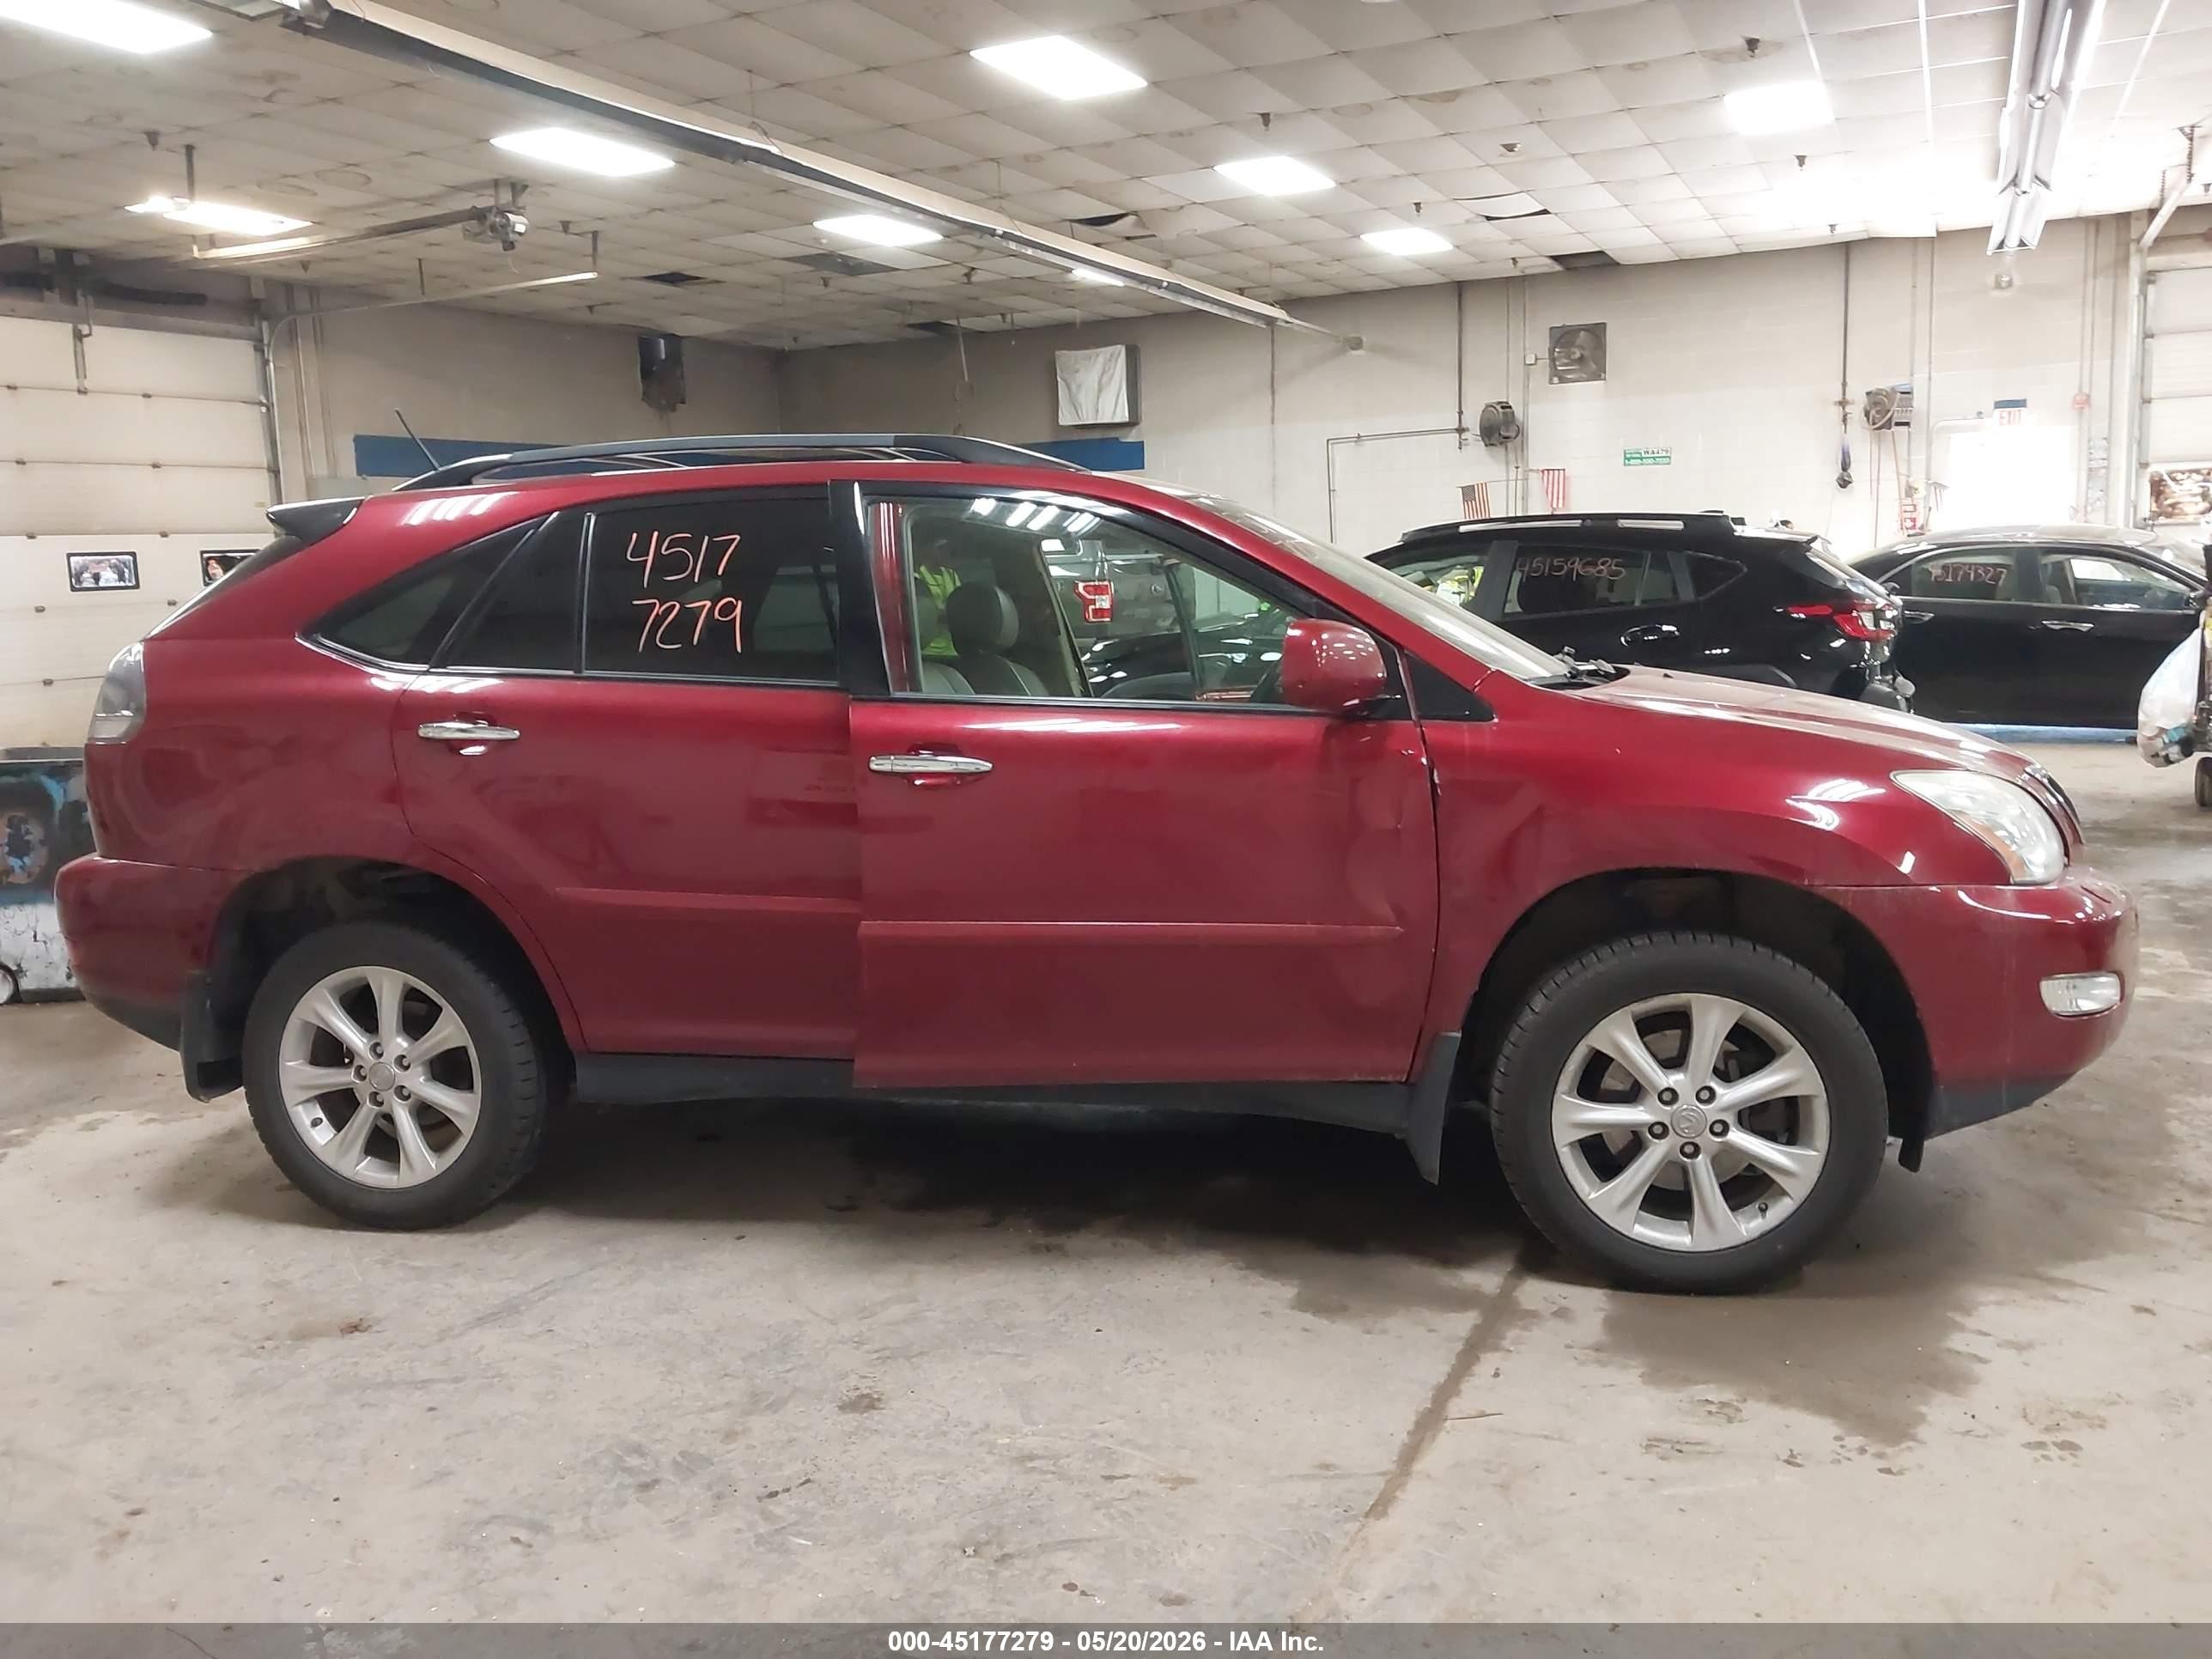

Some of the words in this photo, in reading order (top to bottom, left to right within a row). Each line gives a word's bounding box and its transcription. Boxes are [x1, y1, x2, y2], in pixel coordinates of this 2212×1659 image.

[626, 531, 741, 588] 4517
[1516, 556, 1626, 582] 45159685
[631, 597, 743, 653] 7279
